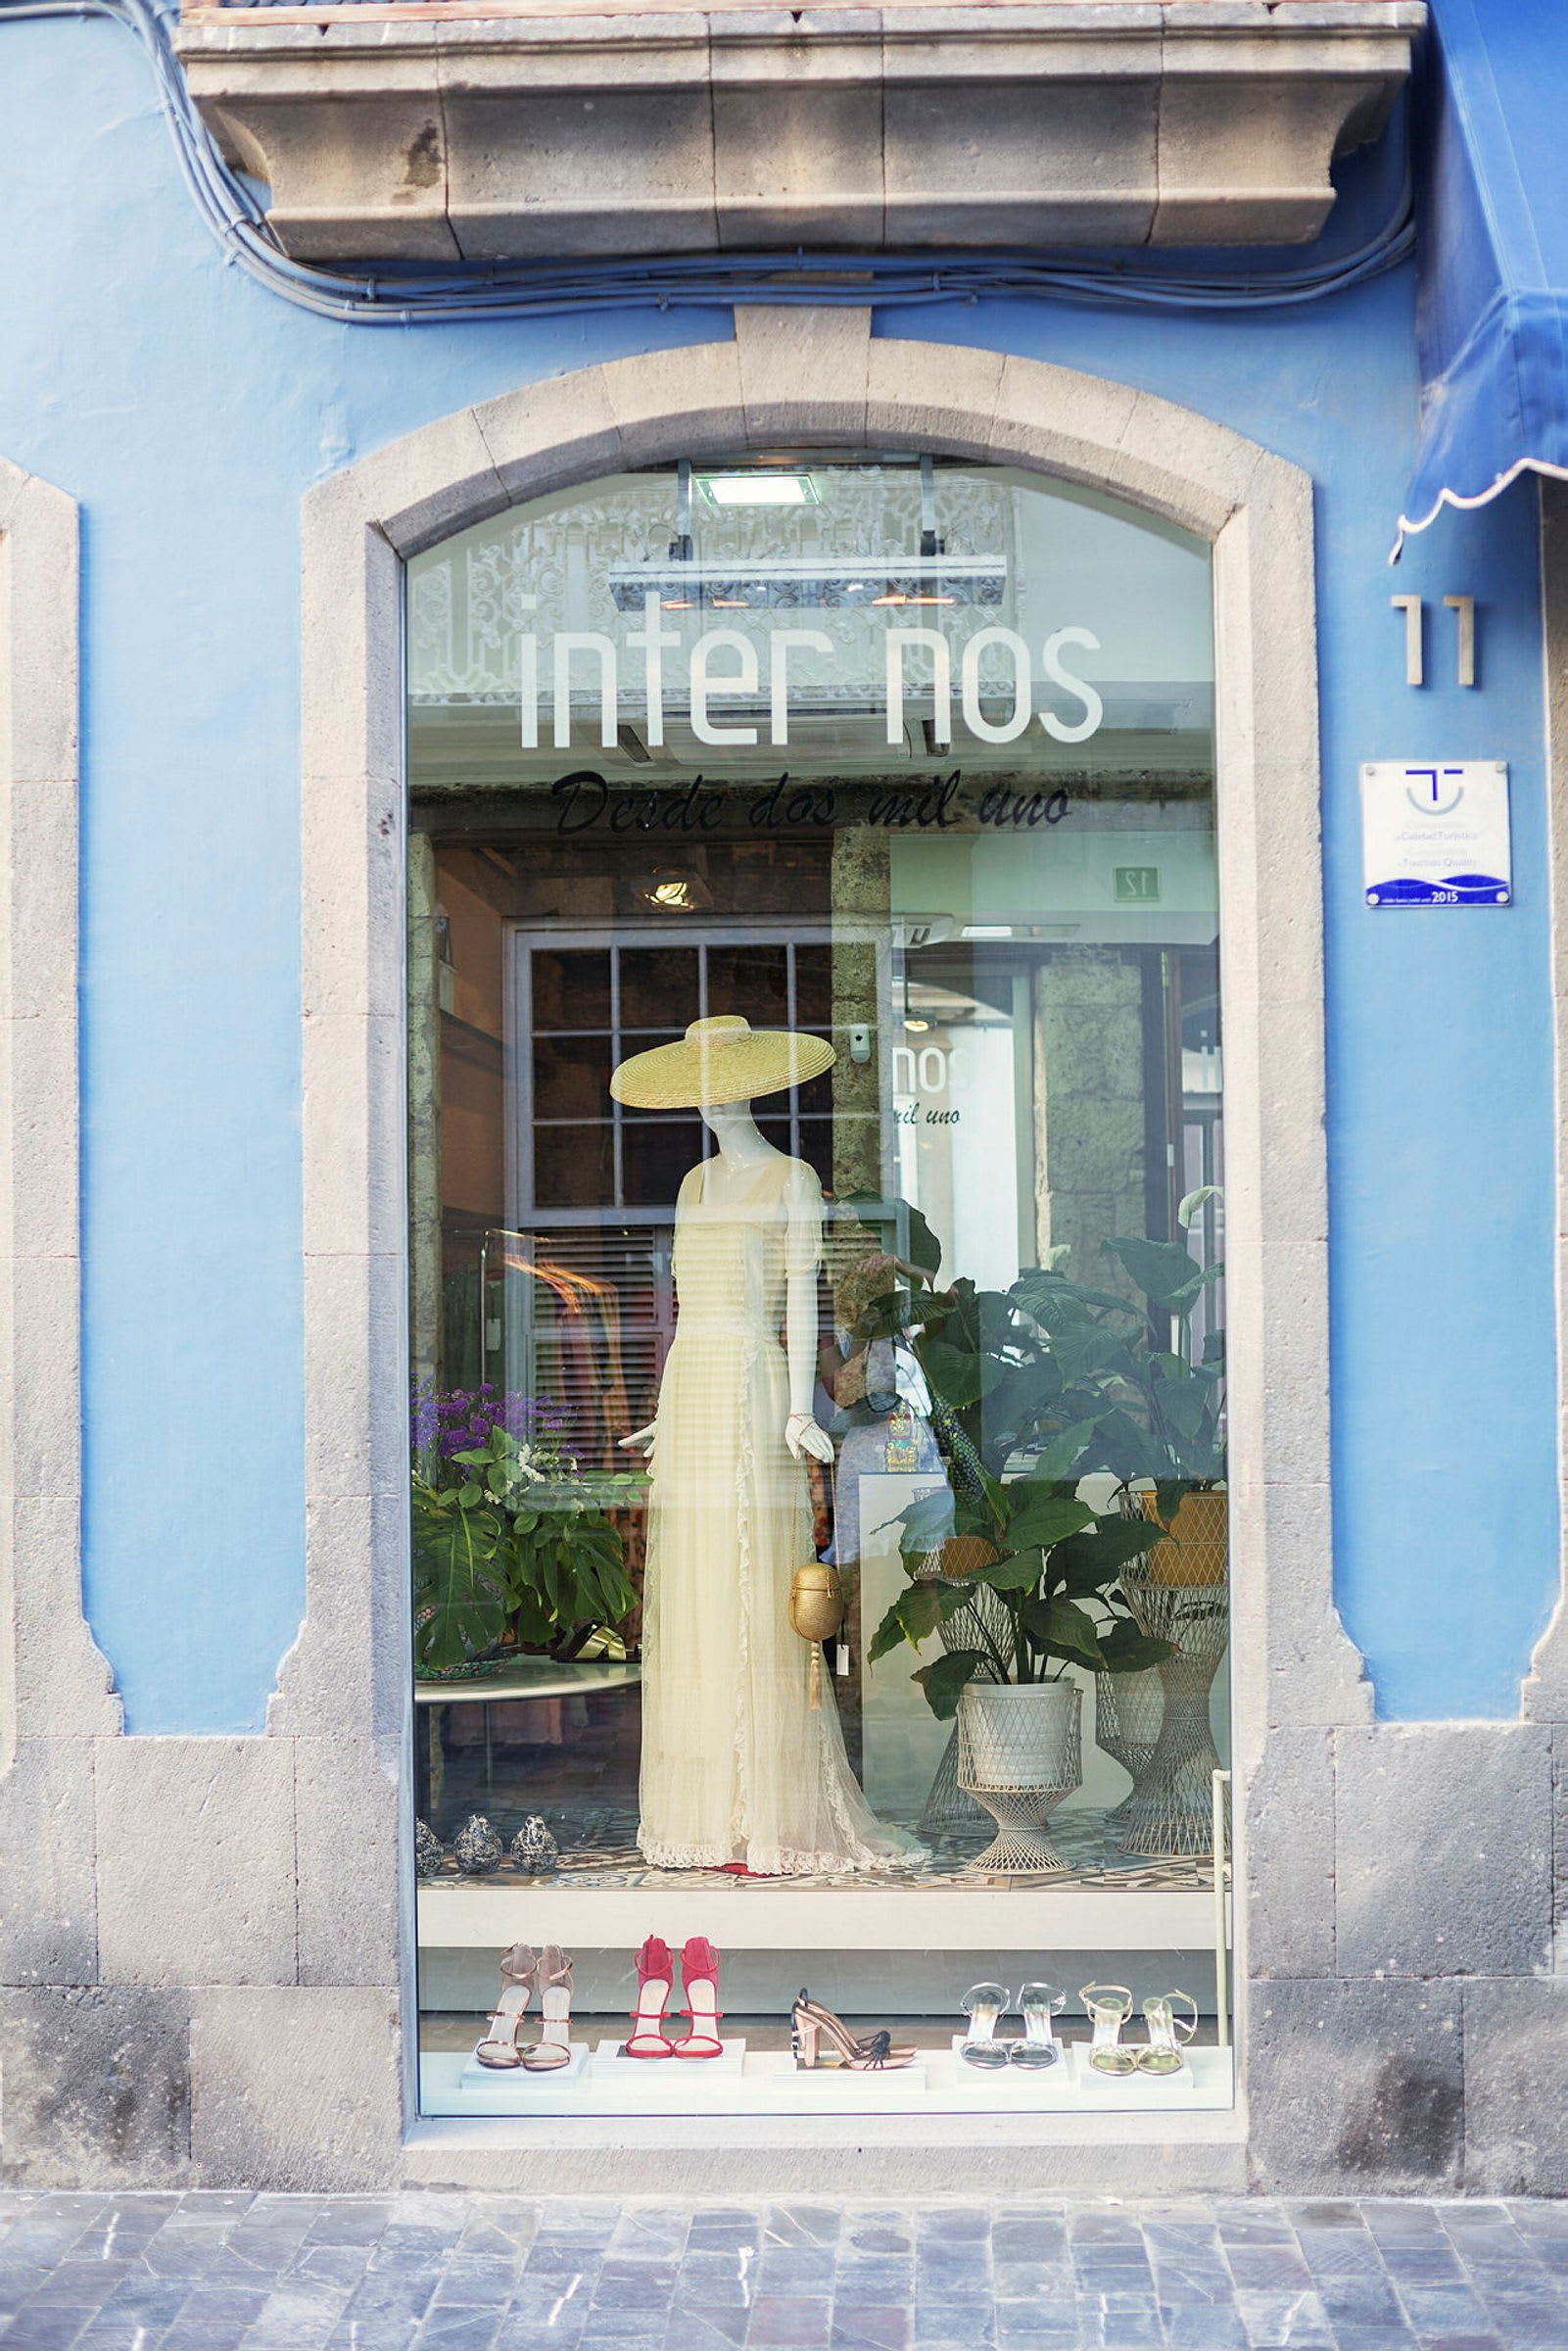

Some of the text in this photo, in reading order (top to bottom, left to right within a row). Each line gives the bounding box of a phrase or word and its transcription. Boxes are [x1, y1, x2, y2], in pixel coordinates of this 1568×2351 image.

[521, 592, 1103, 748] inter nos
[1390, 594, 1475, 686] 11
[551, 769, 1073, 836] Desde dos mil uno
[1431, 890, 1459, 904] 2015
[926, 1109, 961, 1126] uno
